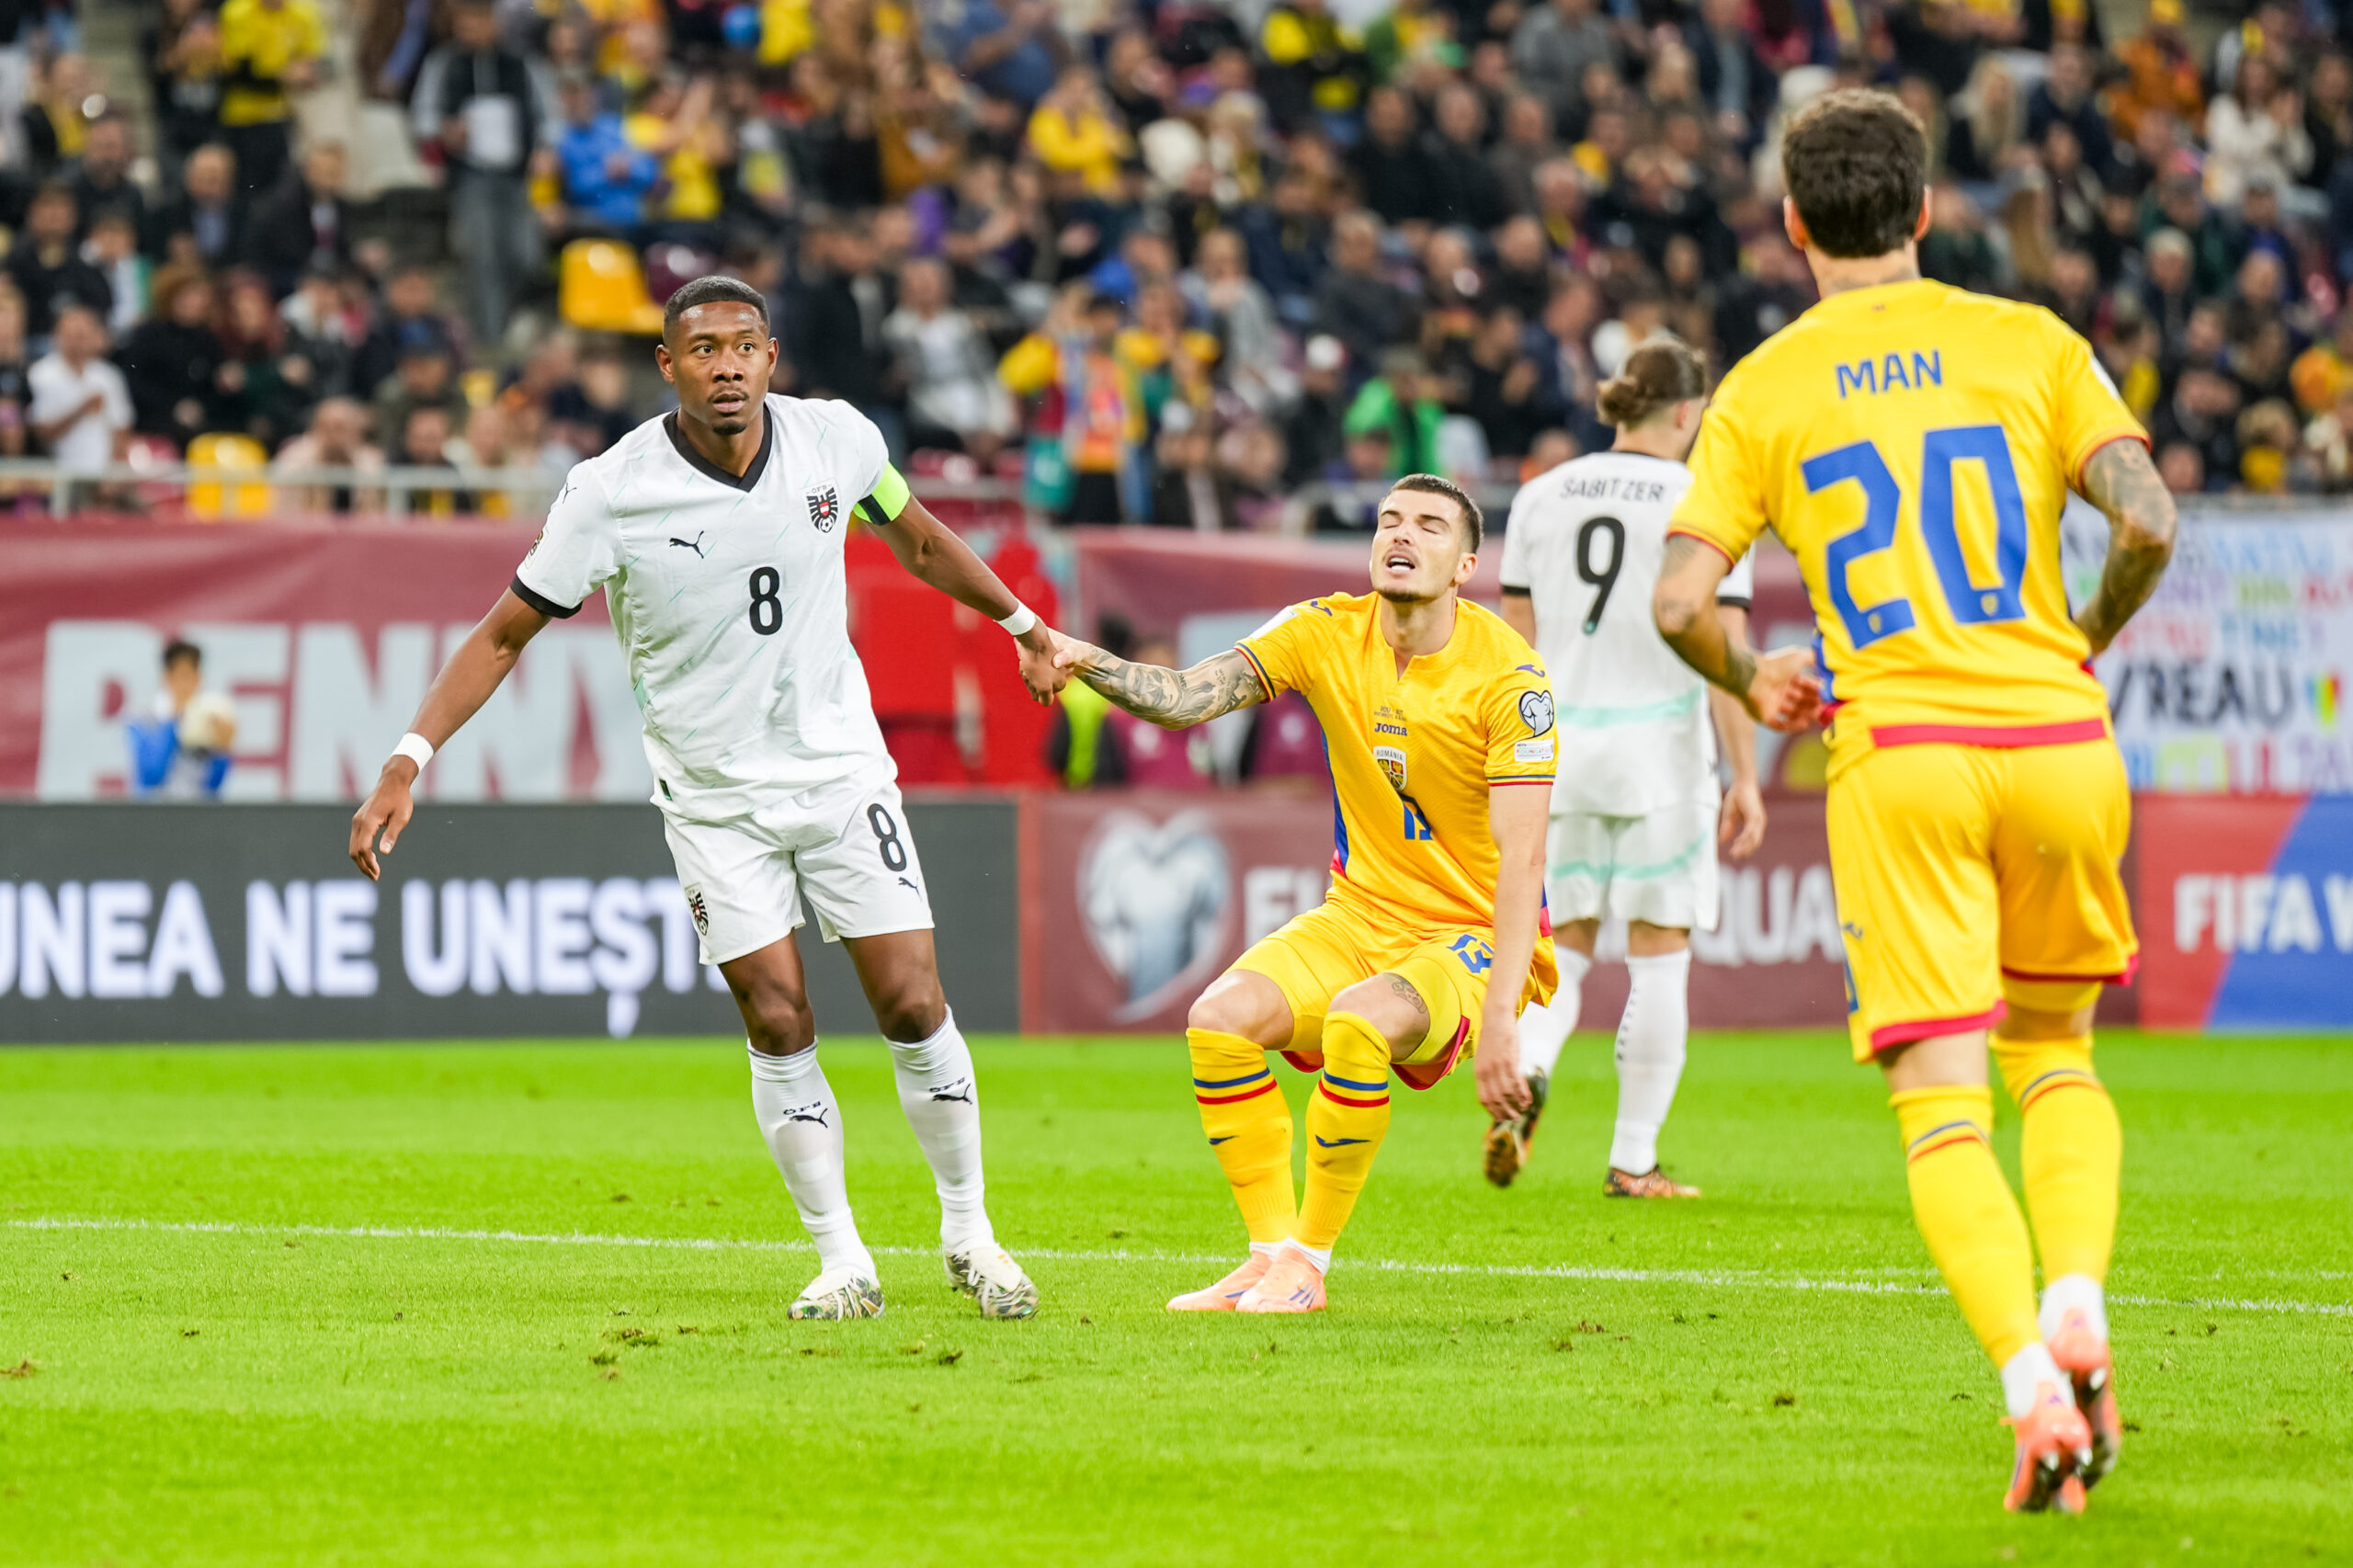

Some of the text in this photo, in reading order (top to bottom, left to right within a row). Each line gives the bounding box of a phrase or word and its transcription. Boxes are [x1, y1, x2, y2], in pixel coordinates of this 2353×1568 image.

[1836, 350, 1941, 399] MAN
[1561, 476, 1665, 502] SABITZER
[1801, 425, 2027, 650] 20
[749, 567, 783, 635] 8
[1577, 517, 1625, 635] 9
[868, 802, 907, 872] 8
[2174, 872, 2325, 954] FIFA
[0, 879, 733, 1039] NEA NE UNEȘT
